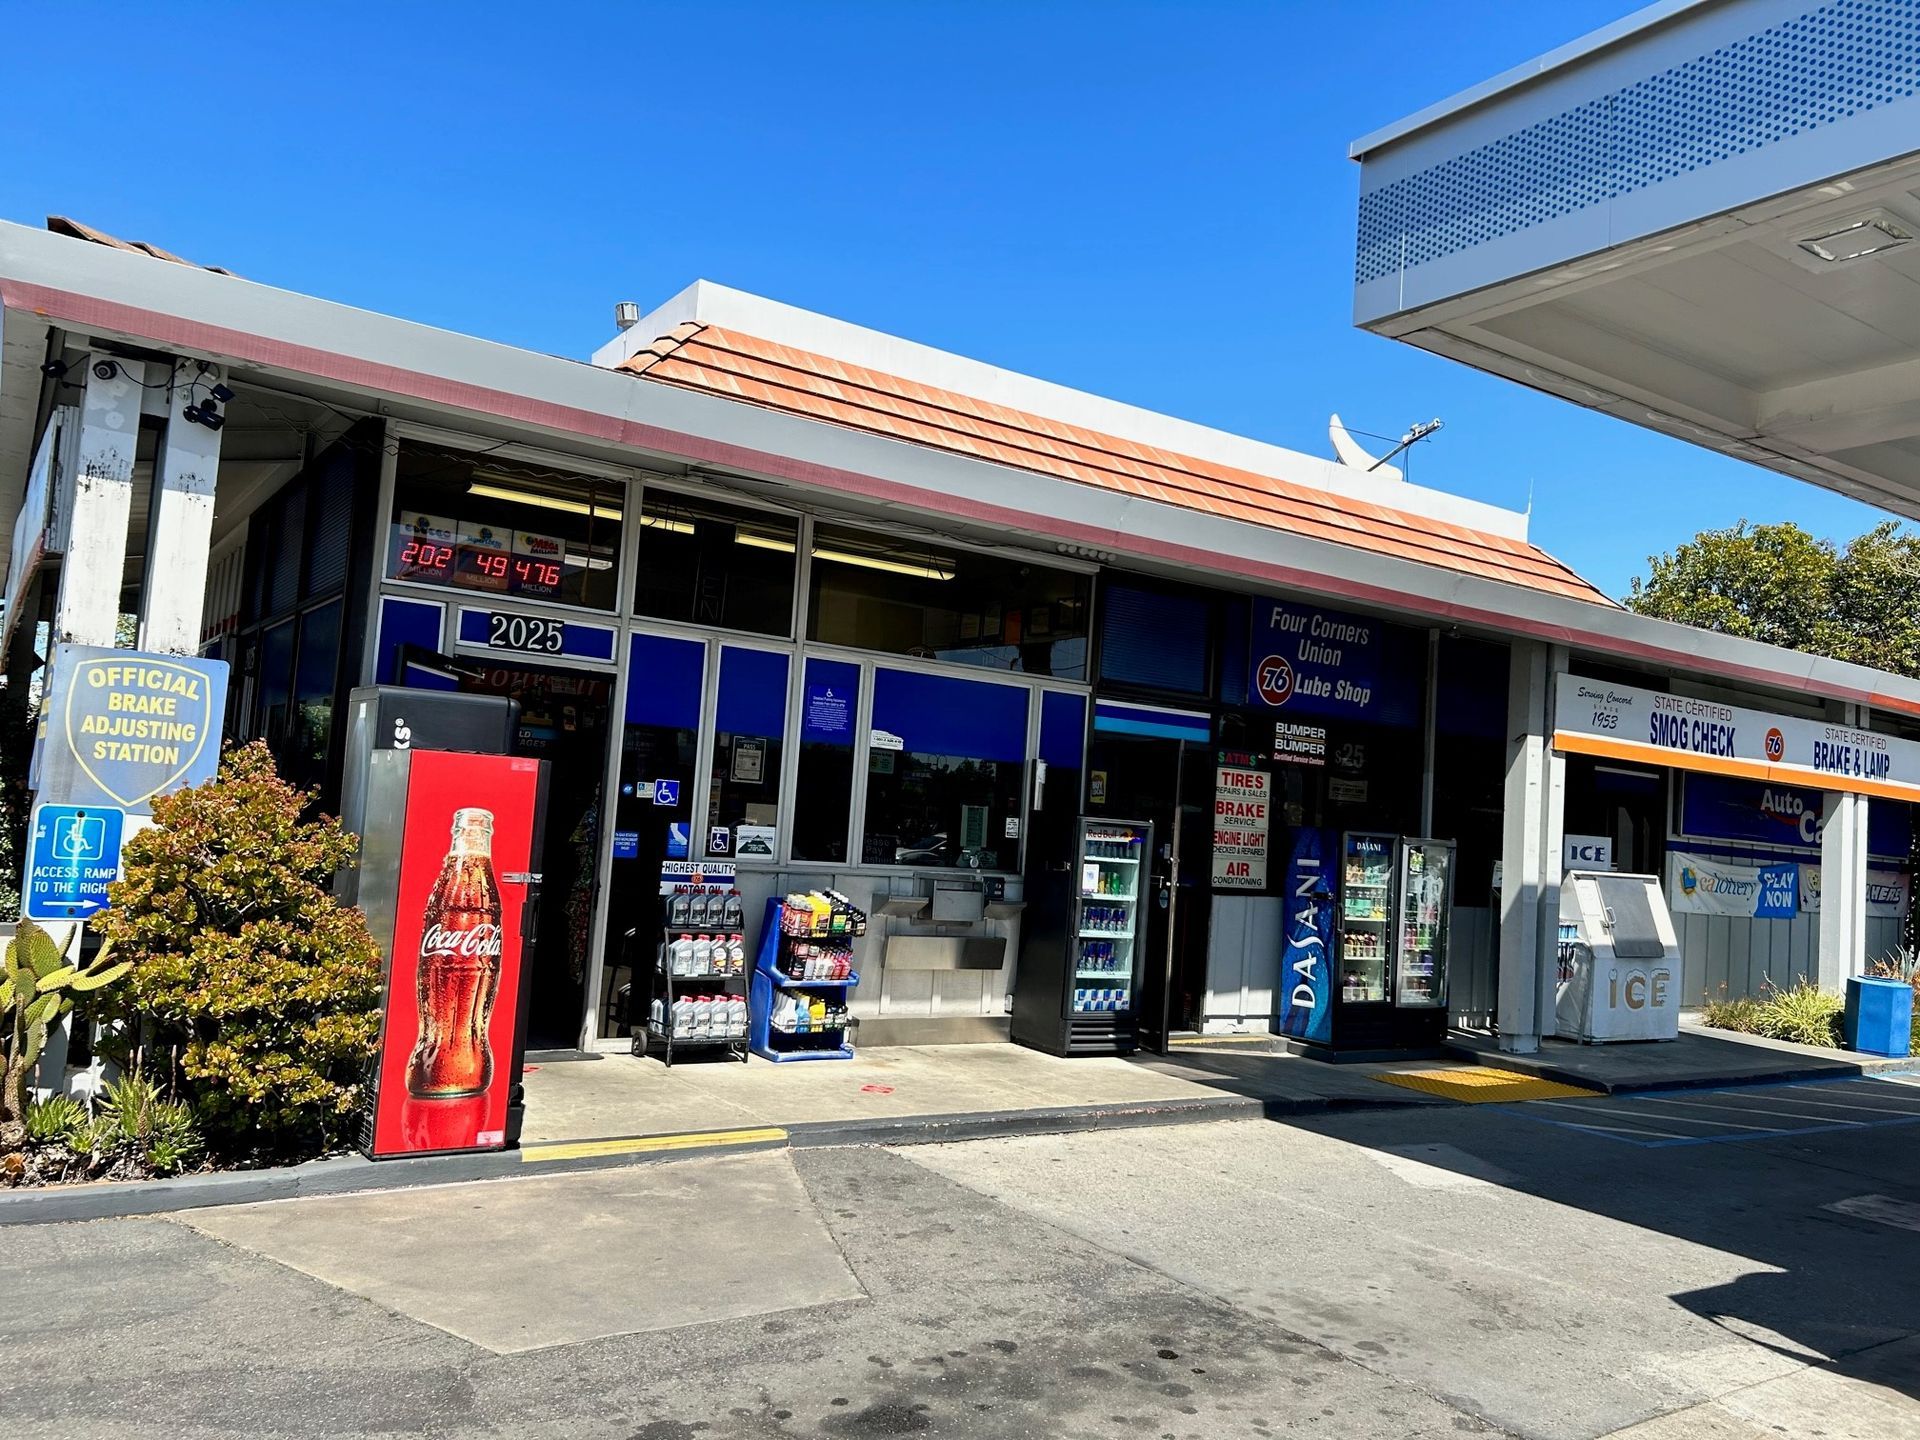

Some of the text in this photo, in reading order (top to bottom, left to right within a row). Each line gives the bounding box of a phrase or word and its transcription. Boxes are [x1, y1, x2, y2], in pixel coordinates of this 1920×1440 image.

[401, 542, 452, 568] 202
[476, 554, 507, 577] 49
[516, 561, 560, 585] 476
[466, 573, 498, 585] MILLION
[521, 583, 552, 593] MILLION
[490, 615, 563, 651] 2025
[1270, 606, 1370, 645] Four Corners
[1297, 639, 1342, 667] Union
[87, 667, 200, 701] OFFICIAL
[1262, 666, 1290, 694] 76
[1293, 672, 1371, 708] Lube Shop
[1577, 686, 1633, 706] Serving Concord
[108, 693, 177, 717] BRAKE
[1654, 695, 1732, 722] STATE CERTIFIED
[80, 716, 197, 742] ADJUSTING
[1591, 711, 1619, 729] 1953
[1275, 722, 1326, 739] BUMPER
[1650, 711, 1736, 759] SMOG CHECK
[1825, 727, 1887, 751] STATE CERTIFIED
[93, 741, 179, 766] STATION
[1274, 739, 1325, 755] BUMPER
[1767, 735, 1782, 754] 76
[1813, 740, 1890, 783] BRAKE & LAMP
[1222, 772, 1264, 789] TIRES
[1216, 786, 1241, 796] REPAIRS
[1248, 790, 1267, 798] SALES
[1760, 788, 1803, 815] Auto
[1216, 801, 1265, 818] BRAKE
[1224, 816, 1256, 826] SERVICE
[1213, 831, 1265, 847] ENGINE LIGHT
[1357, 842, 1381, 852] DASANI
[1213, 846, 1236, 855] CHECKED
[1241, 848, 1265, 856] REPAIRED
[1571, 844, 1605, 862] ICE
[33, 866, 117, 880] ACCESS RAMP
[665, 863, 733, 874] HIGHEST QUALITY
[1226, 862, 1250, 877] AIR
[34, 881, 107, 895] TO THE RIGH
[1212, 876, 1262, 886] CONDITIONING
[1764, 873, 1794, 888] PLAY
[1765, 892, 1792, 907] NOW
[421, 923, 501, 957] Coca-Cola
[1287, 858, 1324, 1009] DASANI
[1608, 968, 1670, 1010] ICE
